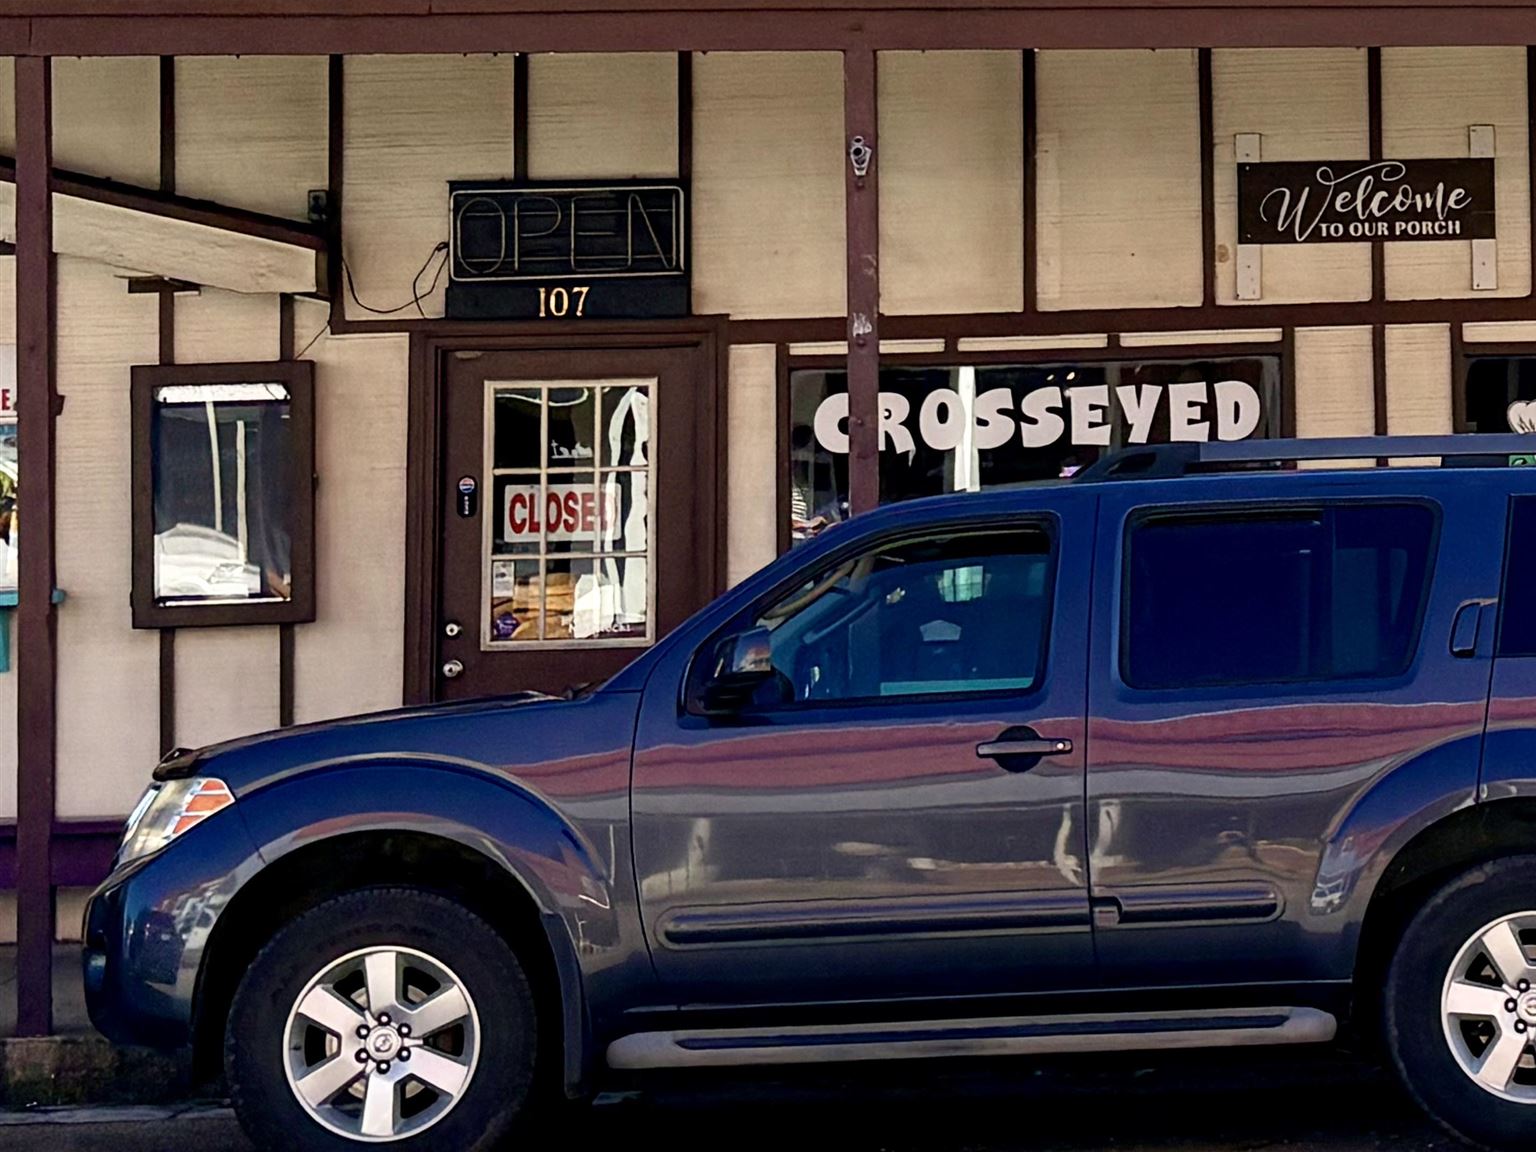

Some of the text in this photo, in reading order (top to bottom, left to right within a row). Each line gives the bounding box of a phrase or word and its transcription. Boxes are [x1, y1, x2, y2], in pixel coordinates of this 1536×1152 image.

[457, 193, 677, 275] OPEN
[1260, 161, 1472, 242] Welcome
[1319, 219, 1461, 237] TO OUR PORCH
[537, 286, 591, 318] 107
[813, 380, 1261, 466] CROSSEYED
